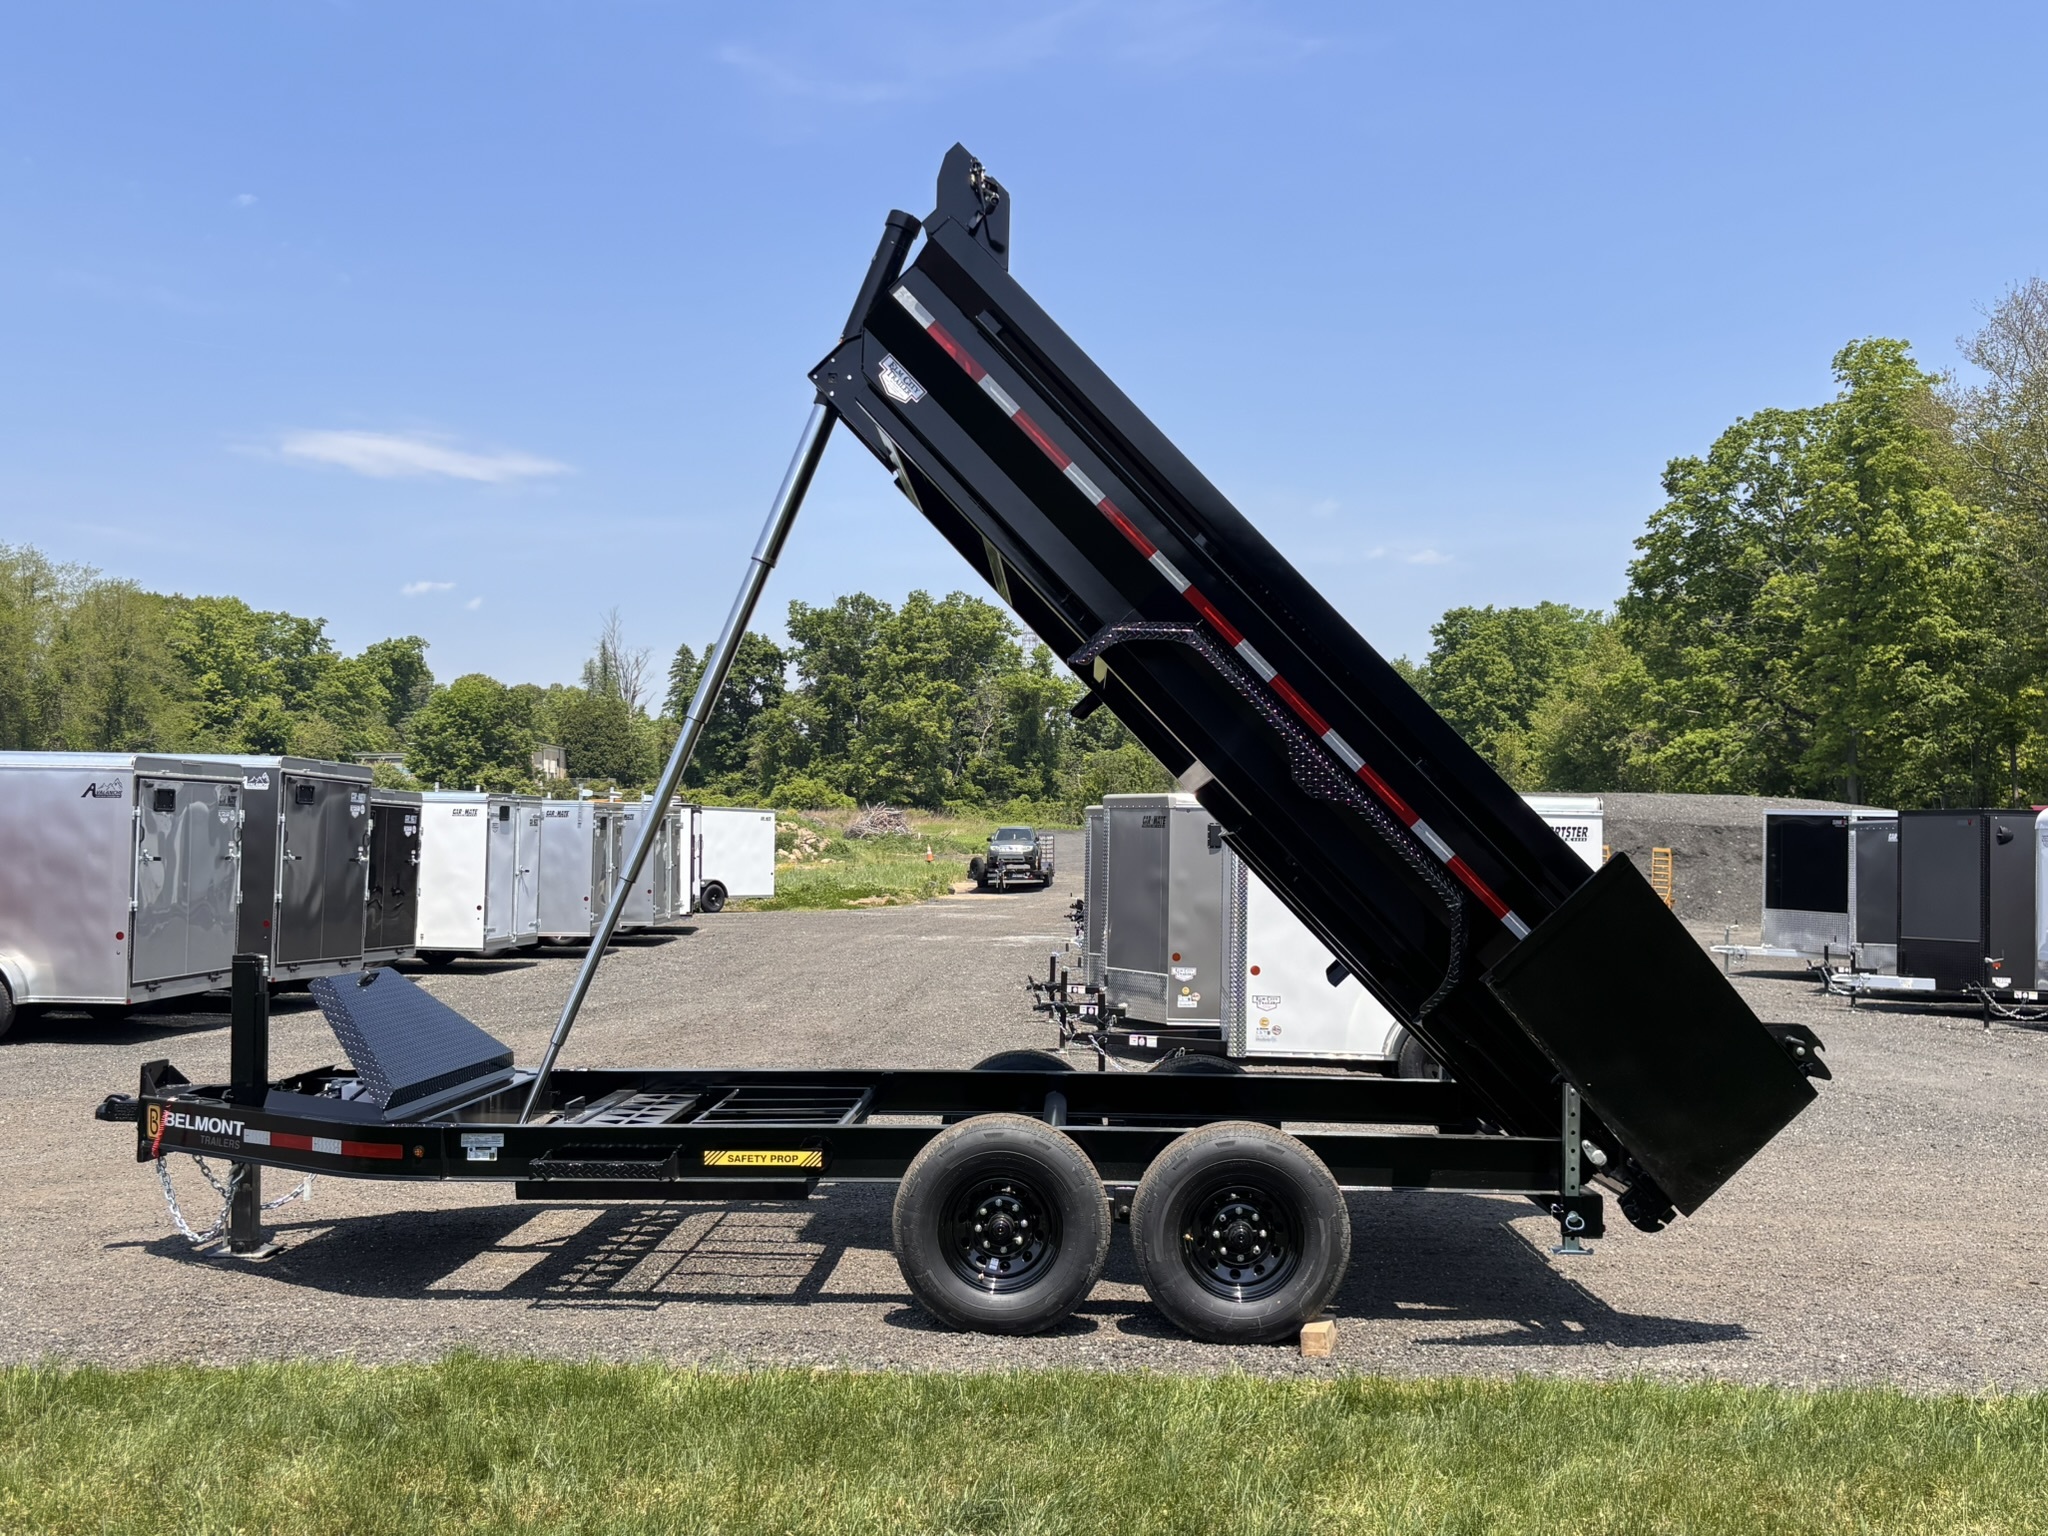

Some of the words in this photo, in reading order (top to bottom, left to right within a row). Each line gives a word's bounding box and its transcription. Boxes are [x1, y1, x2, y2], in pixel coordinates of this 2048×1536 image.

[887, 369, 912, 396] TRAILER
[903, 376, 921, 394] CITY
[165, 1111, 245, 1136] BELMONT
[200, 1134, 240, 1150] TRAILERS
[727, 1154, 767, 1163] SAFETY
[770, 1154, 799, 1163] PROP
